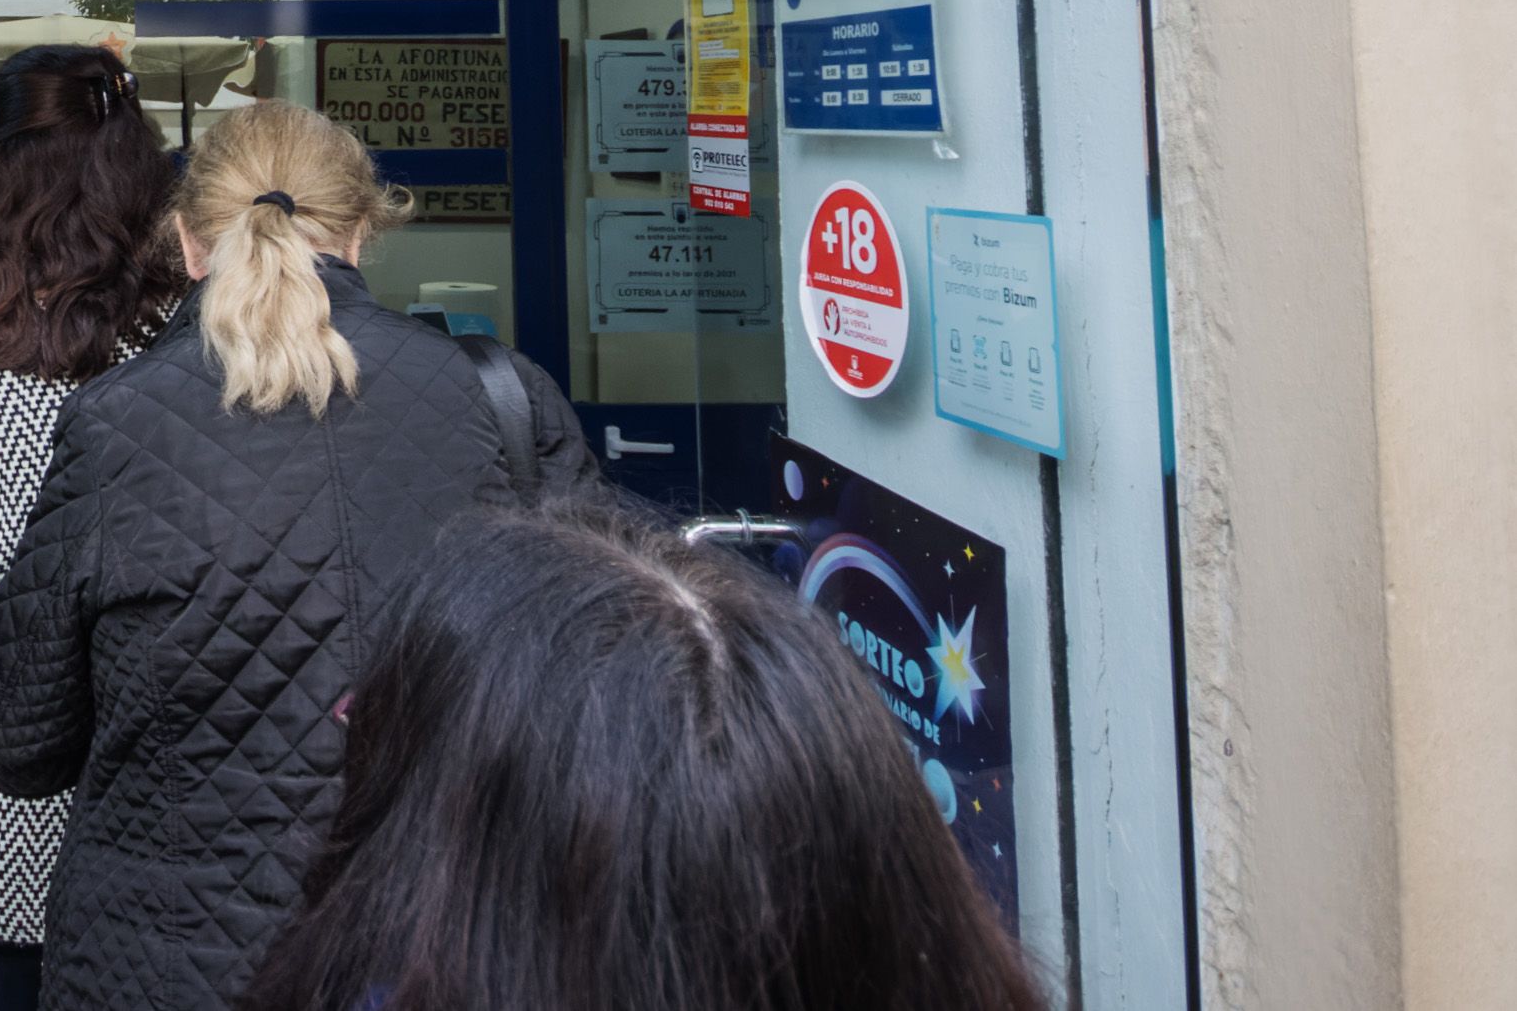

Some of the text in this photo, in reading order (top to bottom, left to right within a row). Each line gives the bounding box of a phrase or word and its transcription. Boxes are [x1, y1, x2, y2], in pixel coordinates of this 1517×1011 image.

[833, 21, 880, 40] HORARIO
[328, 66, 393, 82] EN ESTA
[386, 85, 500, 100] SE PAGARON
[620, 128, 663, 136] LOTERIA
[665, 128, 678, 136] LA
[702, 150, 747, 167] PROTELEC
[821, 206, 878, 275] +18
[618, 288, 678, 297] LOTERIA LA
[1003, 286, 1038, 309] Bizum
[837, 610, 925, 699] SORTEO
